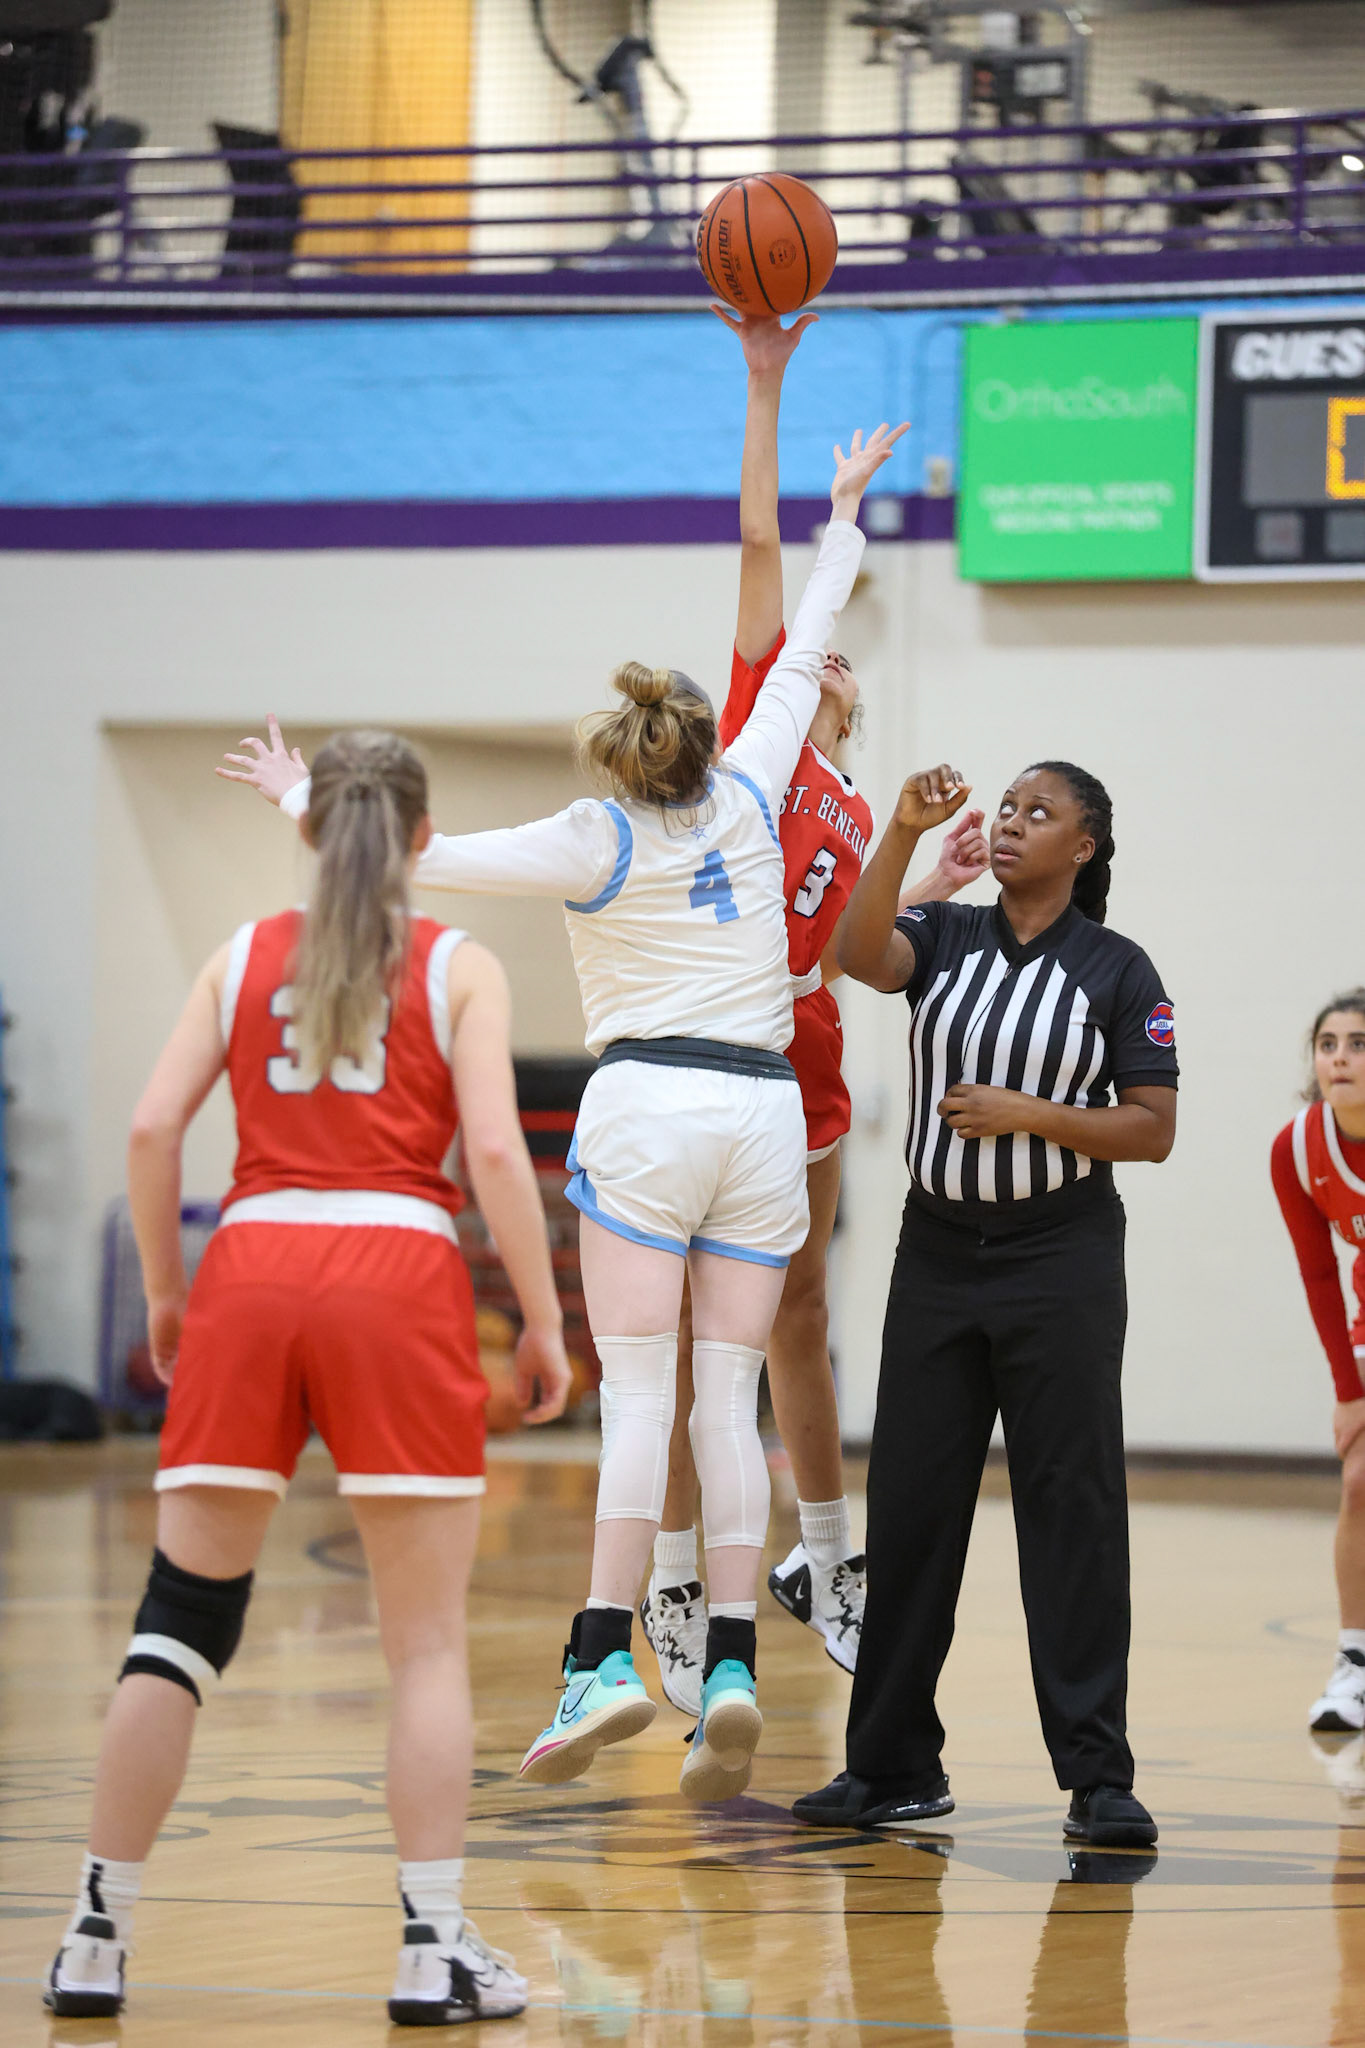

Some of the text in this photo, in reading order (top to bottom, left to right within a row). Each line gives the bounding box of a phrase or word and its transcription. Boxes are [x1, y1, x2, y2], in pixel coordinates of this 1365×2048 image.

[1231, 328, 1365, 381] GUES
[688, 849, 740, 924] 4
[793, 846, 838, 918] 3
[266, 983, 392, 1095] 33
